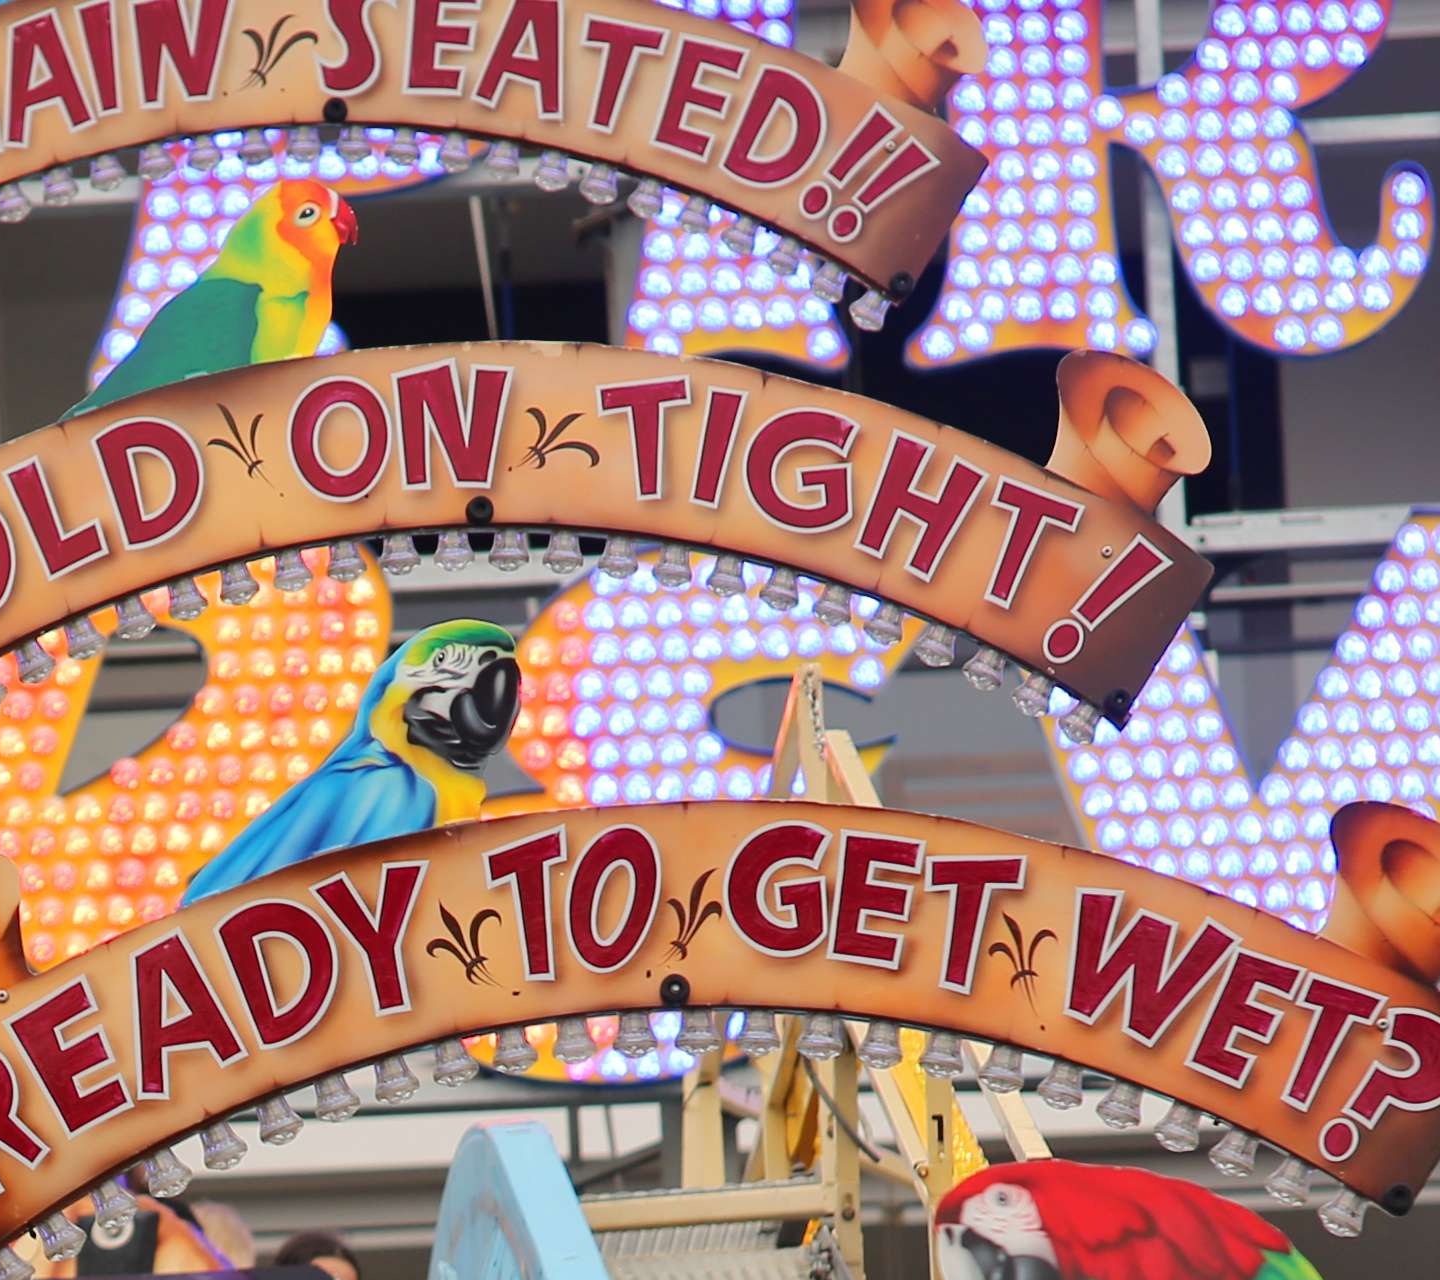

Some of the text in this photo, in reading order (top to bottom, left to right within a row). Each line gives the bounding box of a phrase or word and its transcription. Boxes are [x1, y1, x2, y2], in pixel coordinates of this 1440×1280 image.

[318, 0, 941, 244] SEATED!!
[288, 358, 518, 504] ON
[484, 820, 662, 982] TO
[724, 820, 1025, 994] GET
